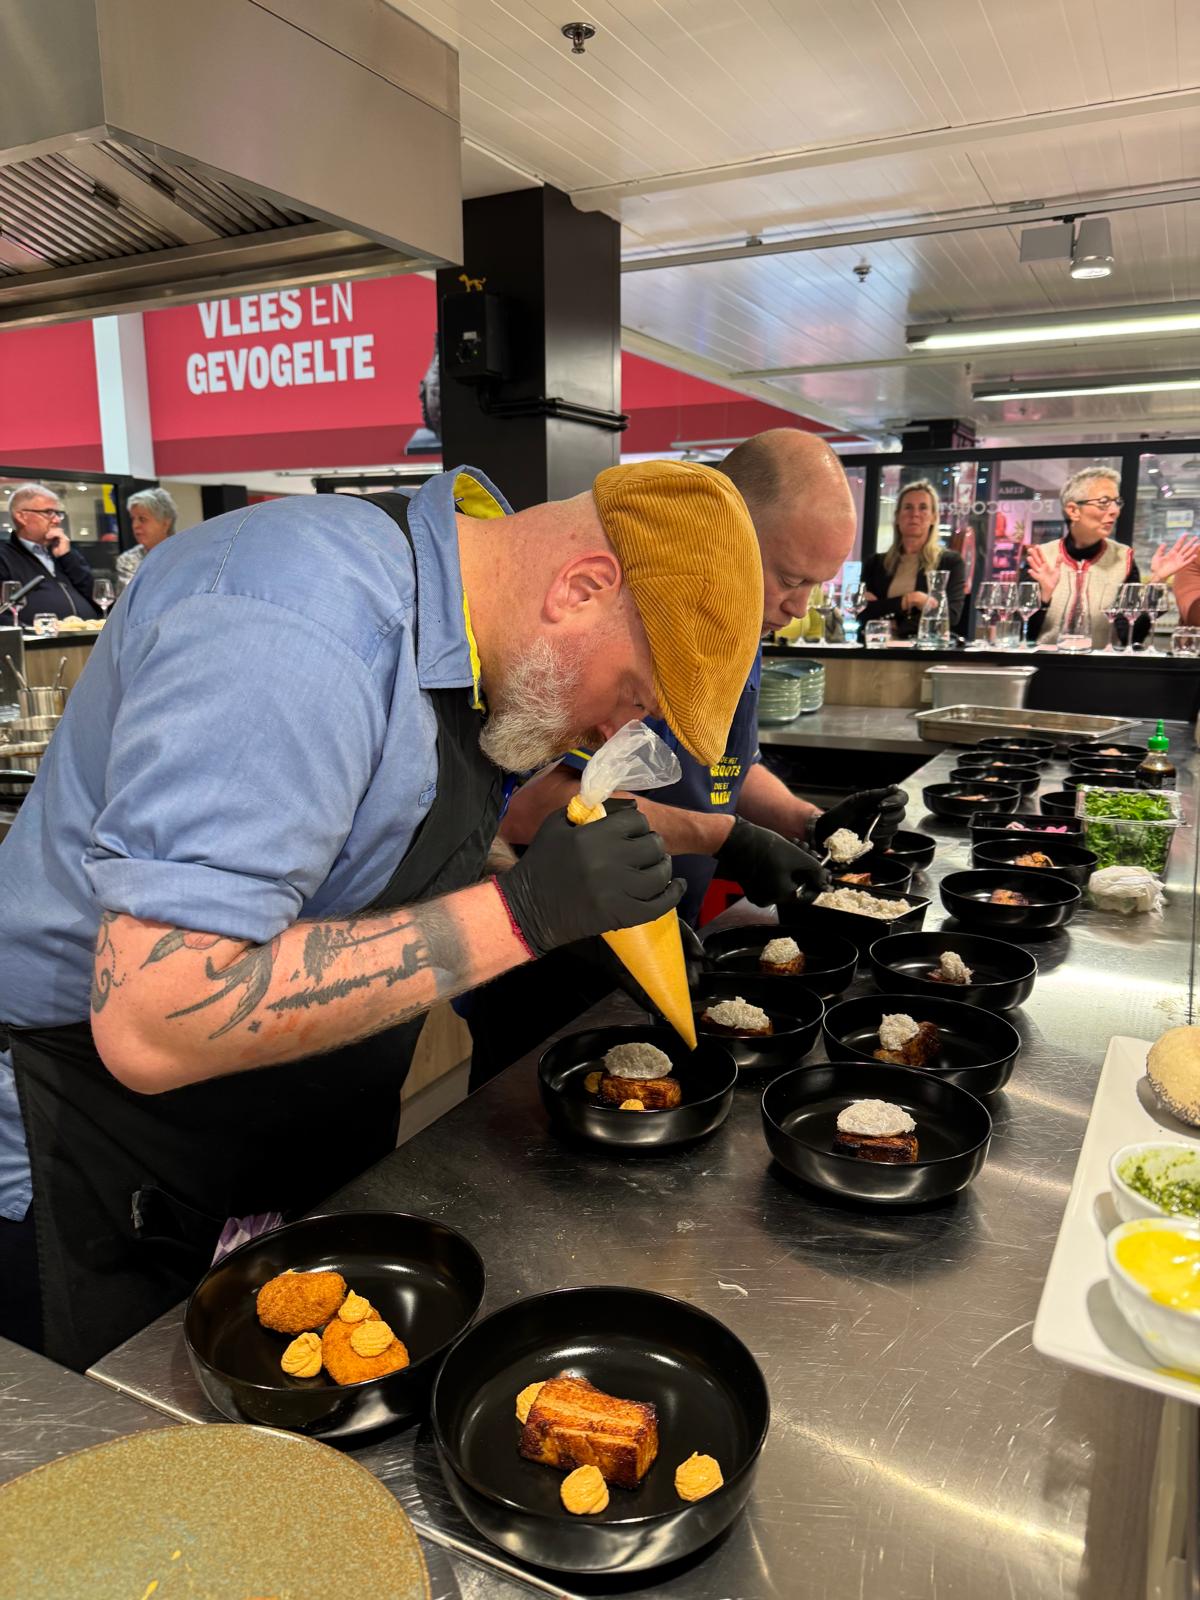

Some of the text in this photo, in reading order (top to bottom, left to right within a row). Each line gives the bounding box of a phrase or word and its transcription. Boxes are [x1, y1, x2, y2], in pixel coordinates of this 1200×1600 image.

[198, 282, 353, 339] VLEES EN
[186, 333, 375, 395] GEVOGELTE
